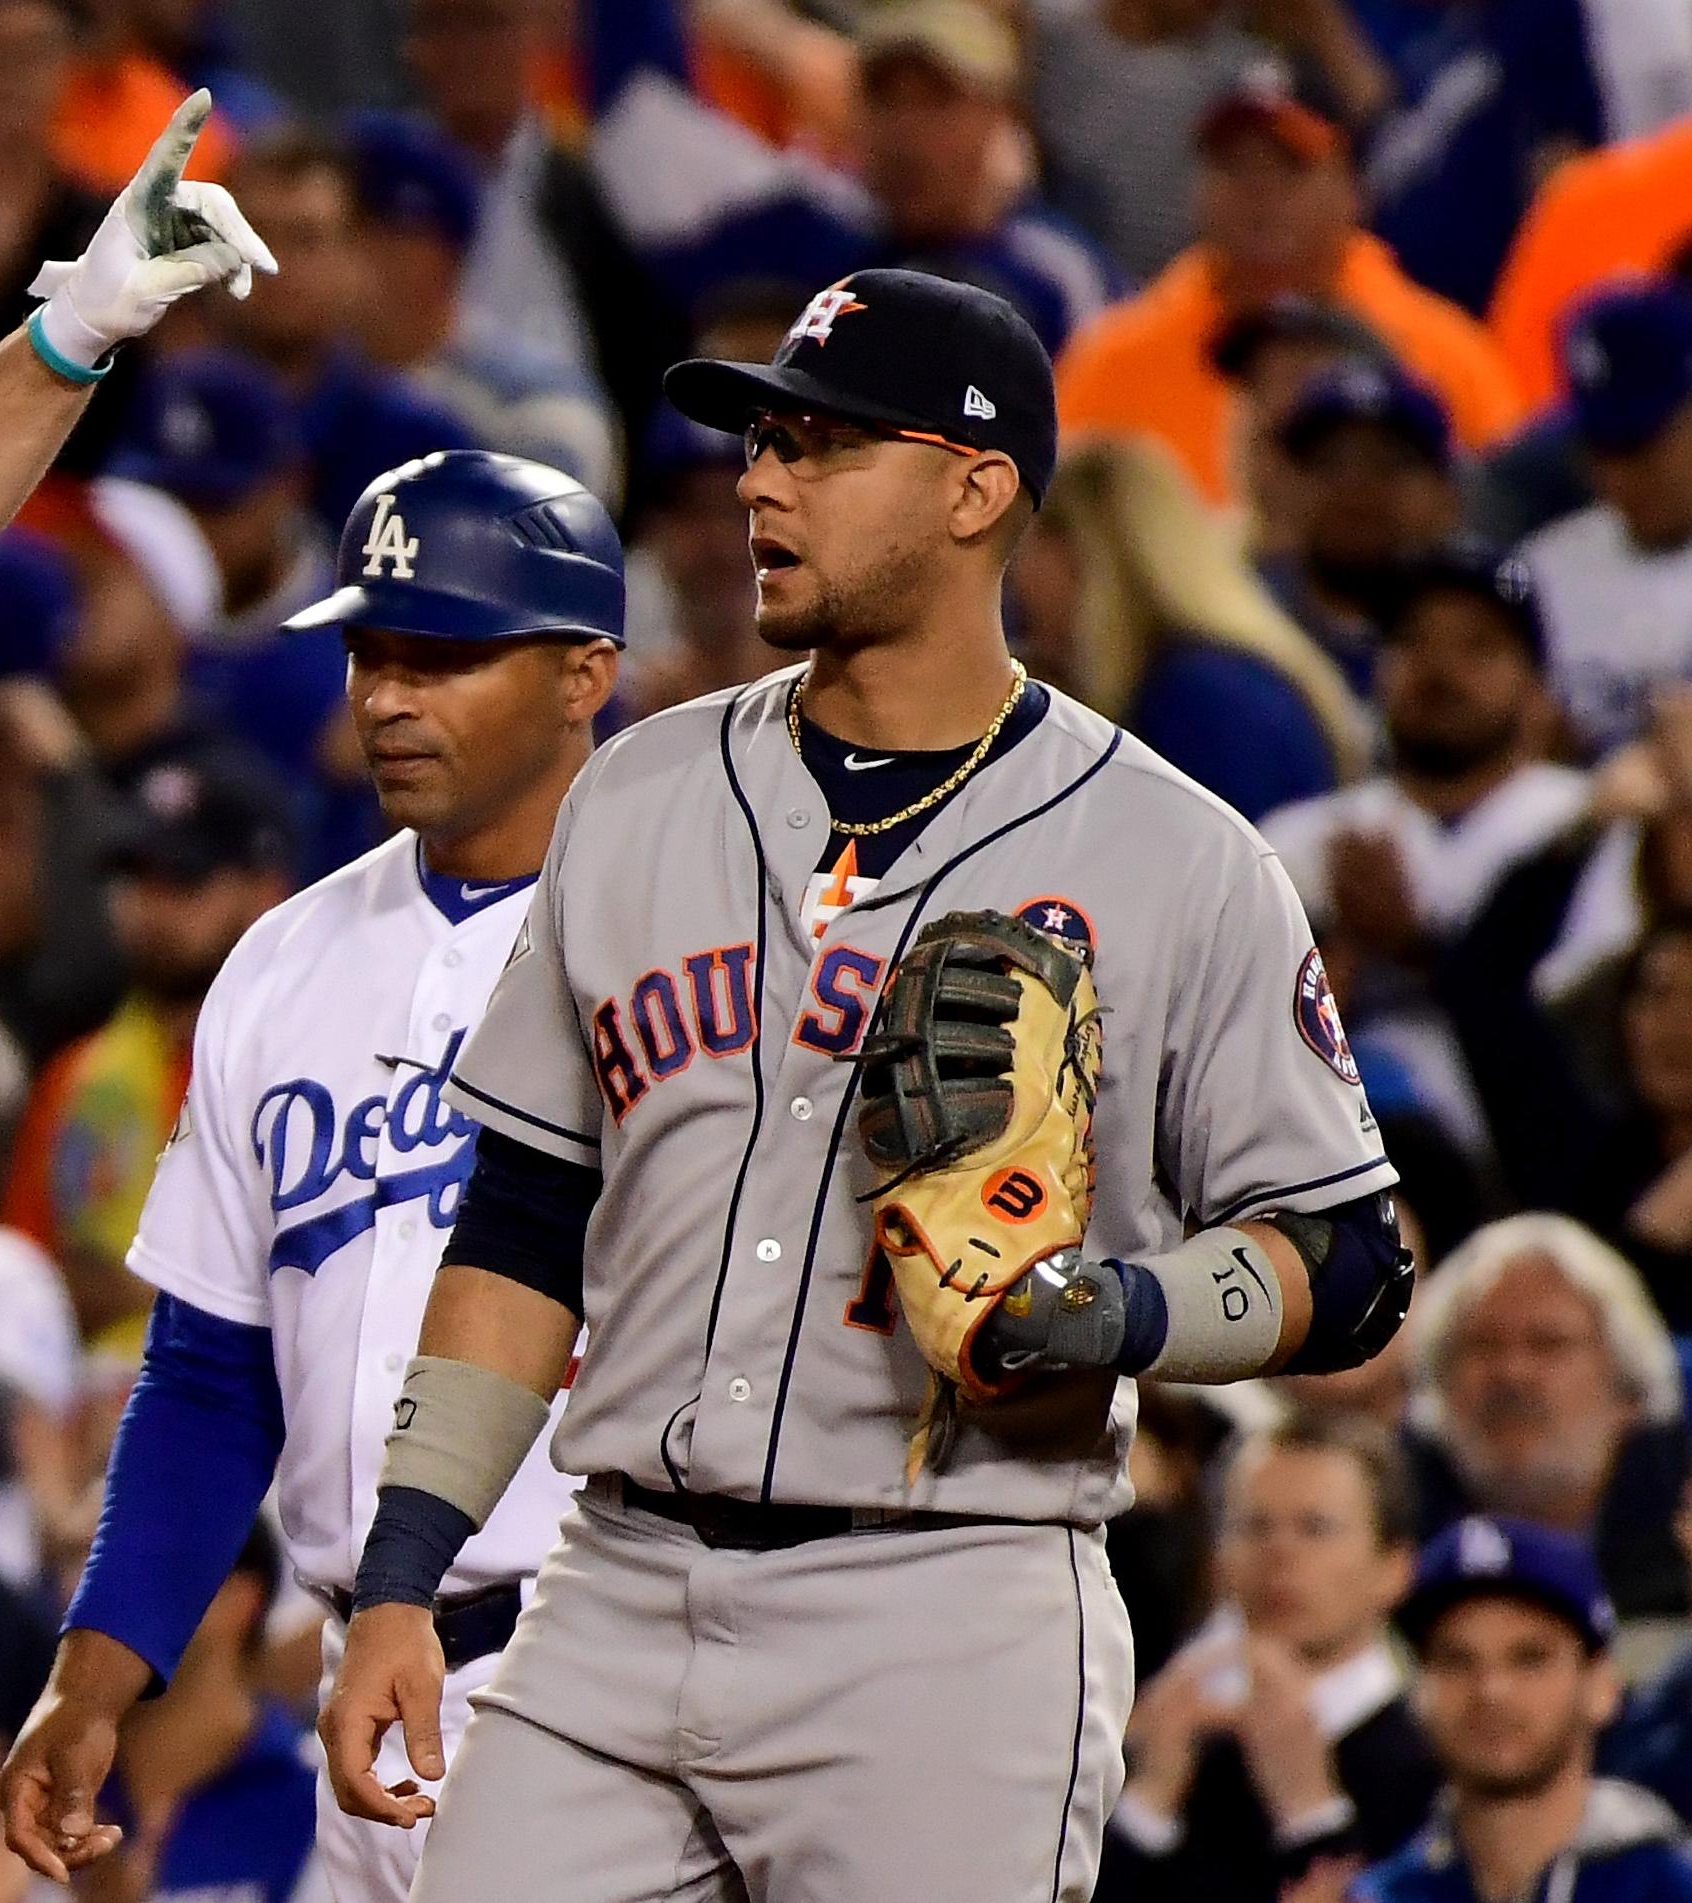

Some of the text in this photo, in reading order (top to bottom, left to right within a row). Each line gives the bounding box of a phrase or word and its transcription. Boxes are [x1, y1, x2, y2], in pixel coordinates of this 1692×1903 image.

[361, 493, 421, 579] LA
[593, 940, 900, 1129] HOUS
[1211, 1266, 1250, 1322] 10
